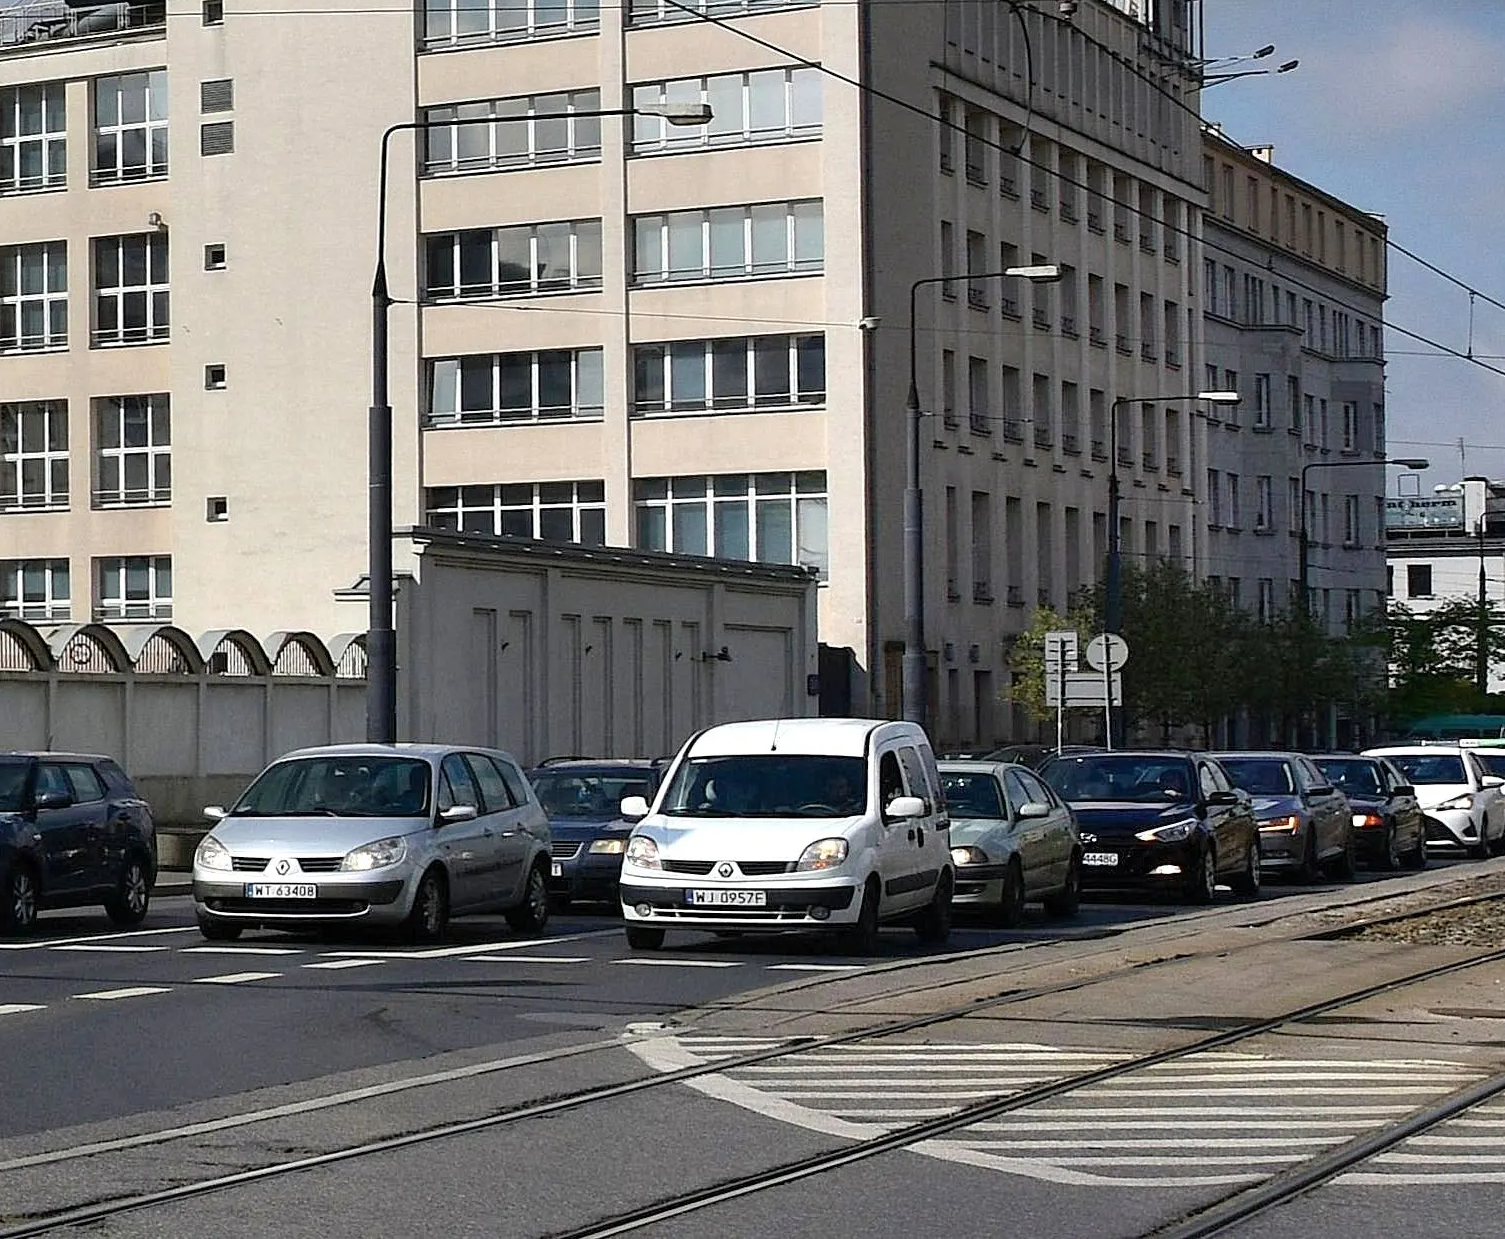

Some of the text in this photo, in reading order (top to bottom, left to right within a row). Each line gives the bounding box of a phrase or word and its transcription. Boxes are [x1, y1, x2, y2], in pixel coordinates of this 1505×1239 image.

[255, 885, 314, 897] WT 63408
[695, 892, 764, 904] WJ 0957F
